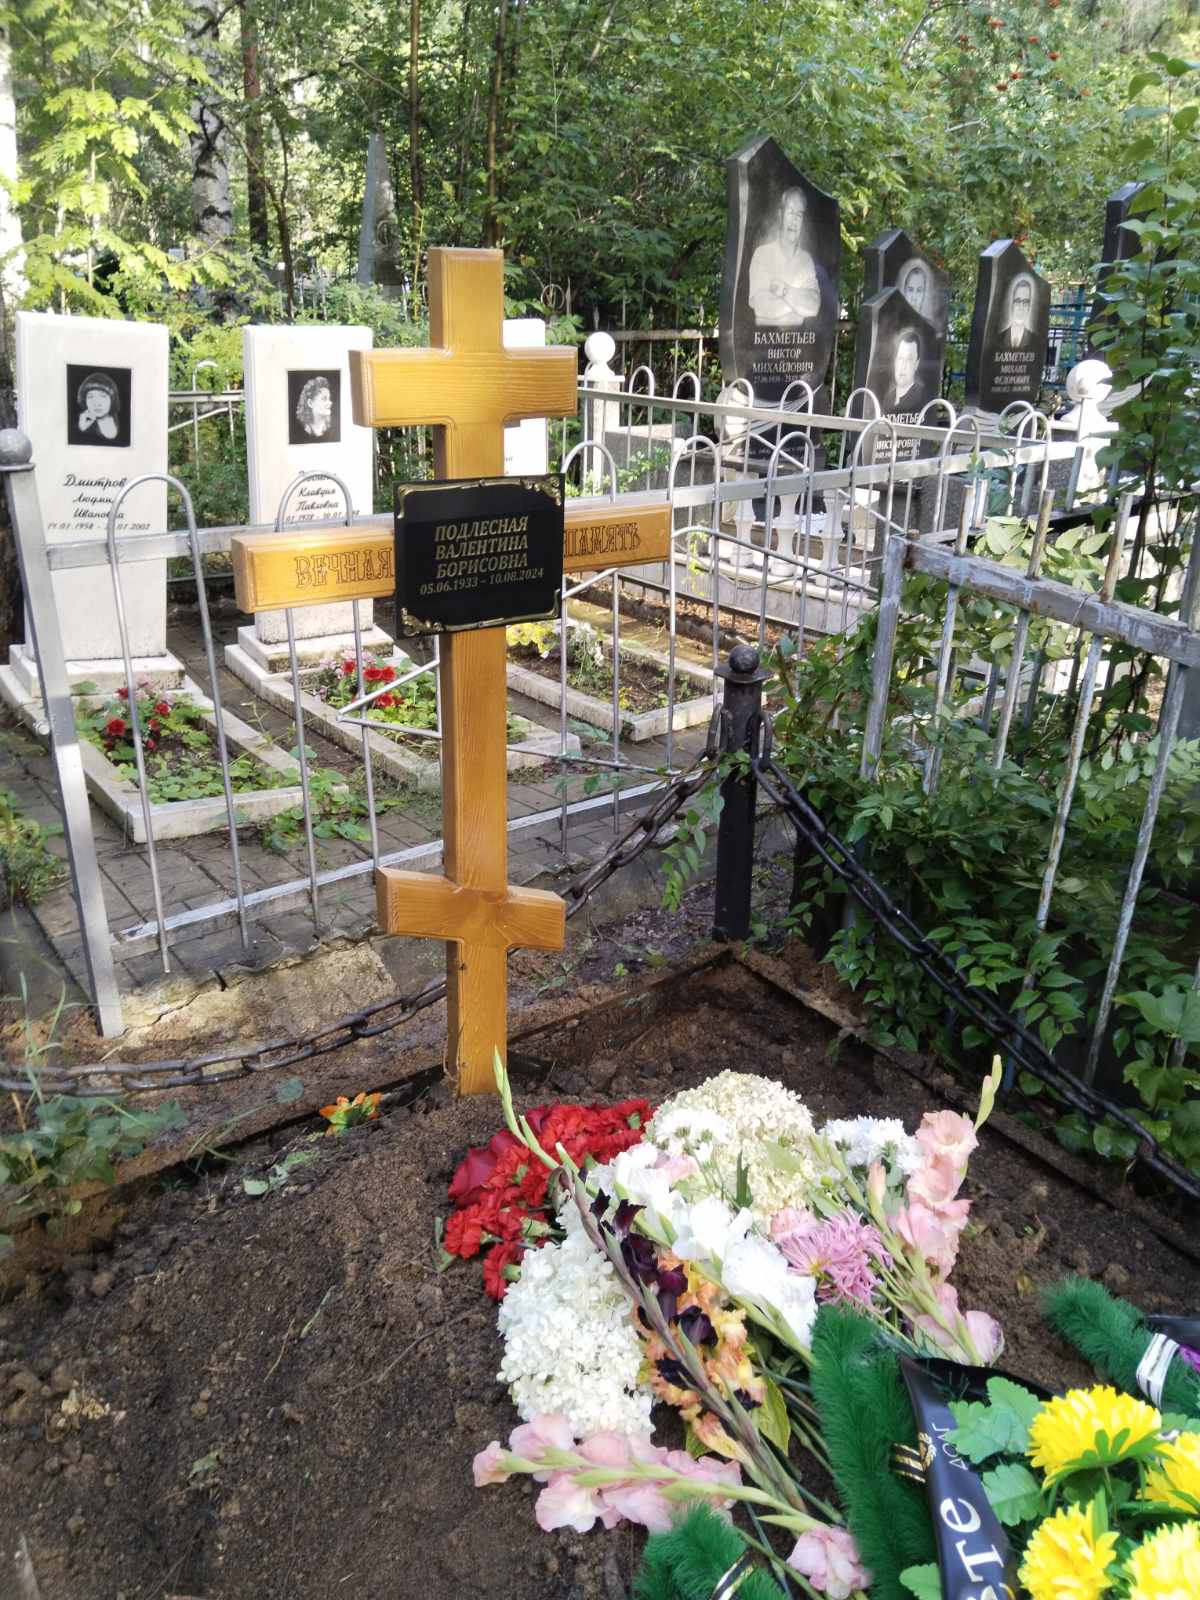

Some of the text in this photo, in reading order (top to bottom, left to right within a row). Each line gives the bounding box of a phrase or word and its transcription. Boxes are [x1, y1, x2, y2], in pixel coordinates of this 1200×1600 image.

[754, 332, 816, 345] БАХМЕТЬЕВ
[752, 361, 814, 373] МИХАЙЛОВИЧ
[767, 349, 802, 359] ВИКТОР
[64, 474, 127, 491] Дмитров
[434, 516, 529, 543] ПОДЛЕСНАЯ
[294, 522, 641, 588] ВЕЧНАЯ ПАМЯТЬ
[435, 535, 529, 561] ВАЛЕНТИНА
[436, 553, 528, 579] БОРИСОВНА
[420, 576, 479, 596] 05.06.1933
[489, 567, 545, 586] 10.08.2024
